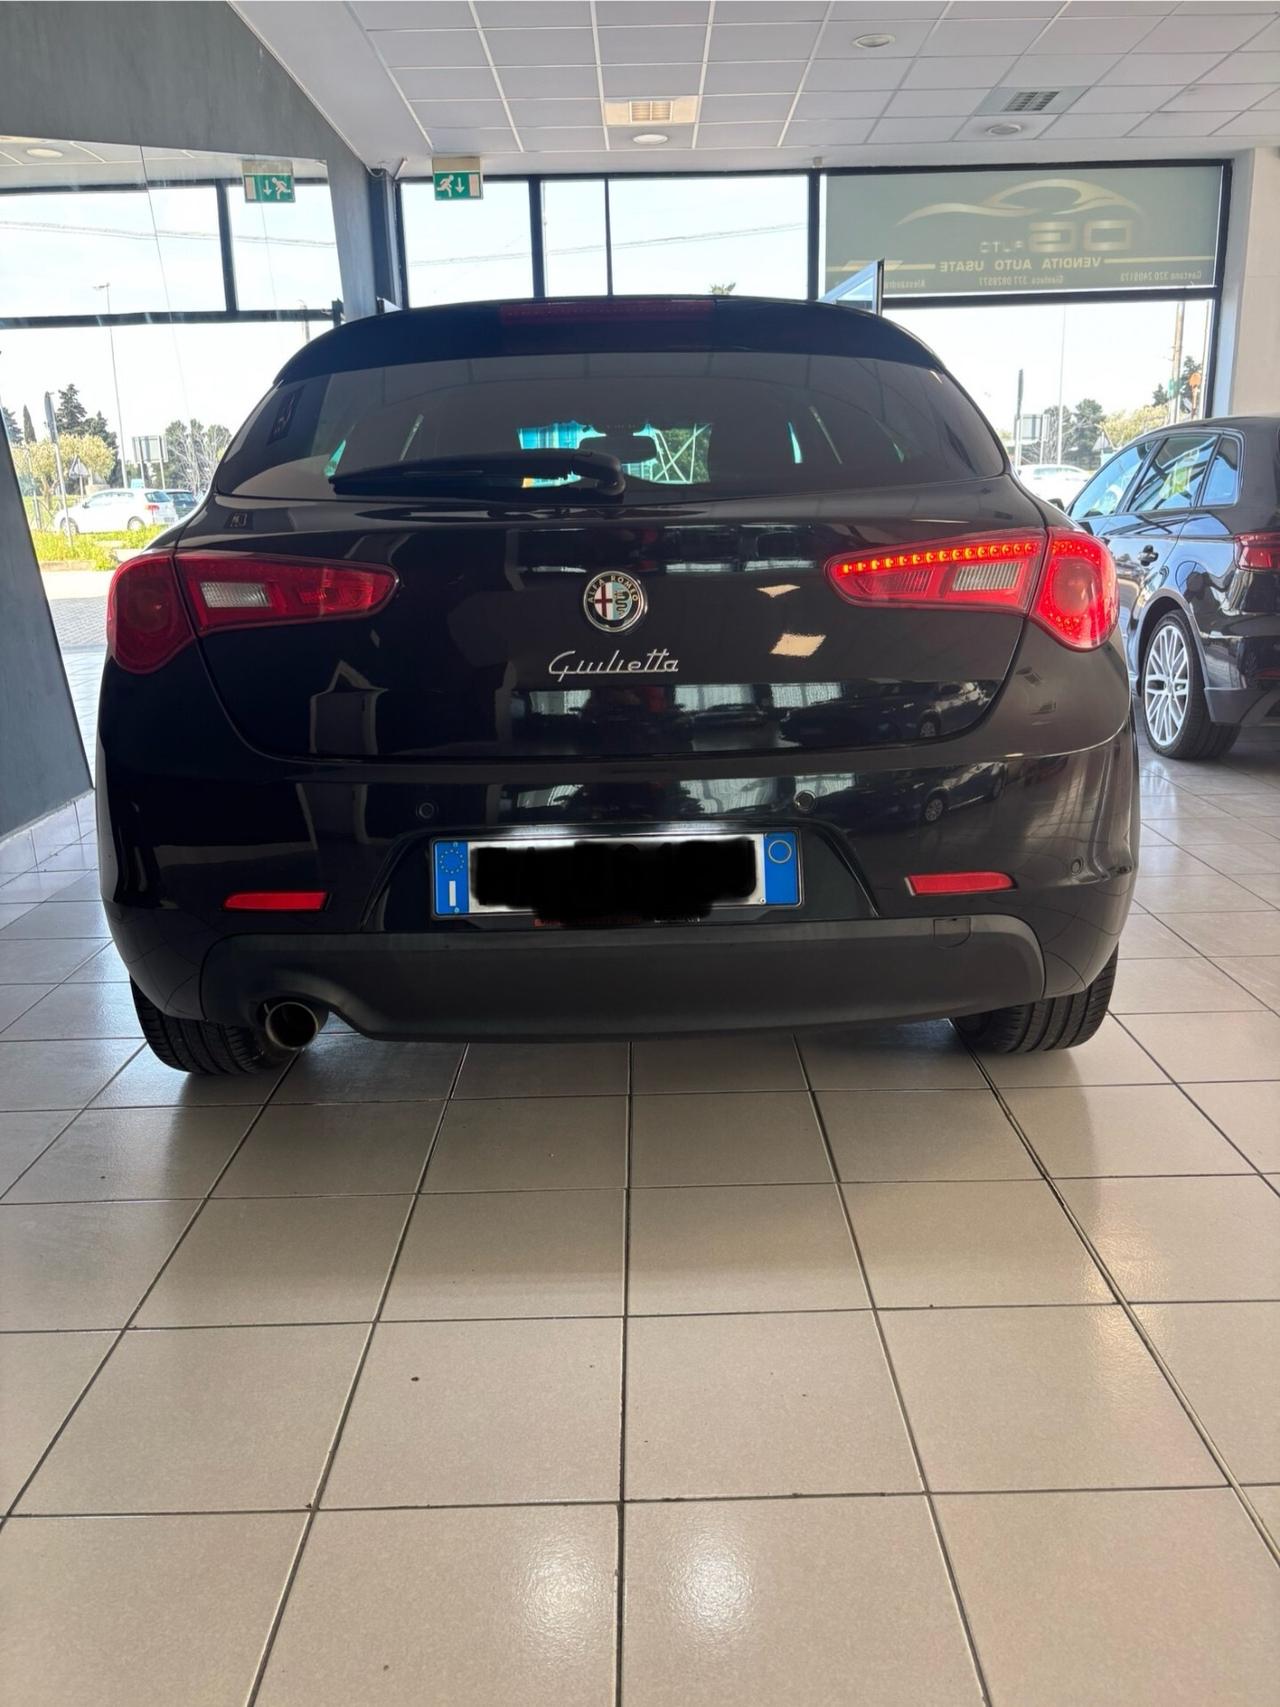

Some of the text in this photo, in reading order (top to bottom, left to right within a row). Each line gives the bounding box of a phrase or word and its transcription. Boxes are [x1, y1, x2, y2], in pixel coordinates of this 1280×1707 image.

[587, 575, 639, 604] ALFA ROMEO
[548, 648, 679, 683] Giulietta
